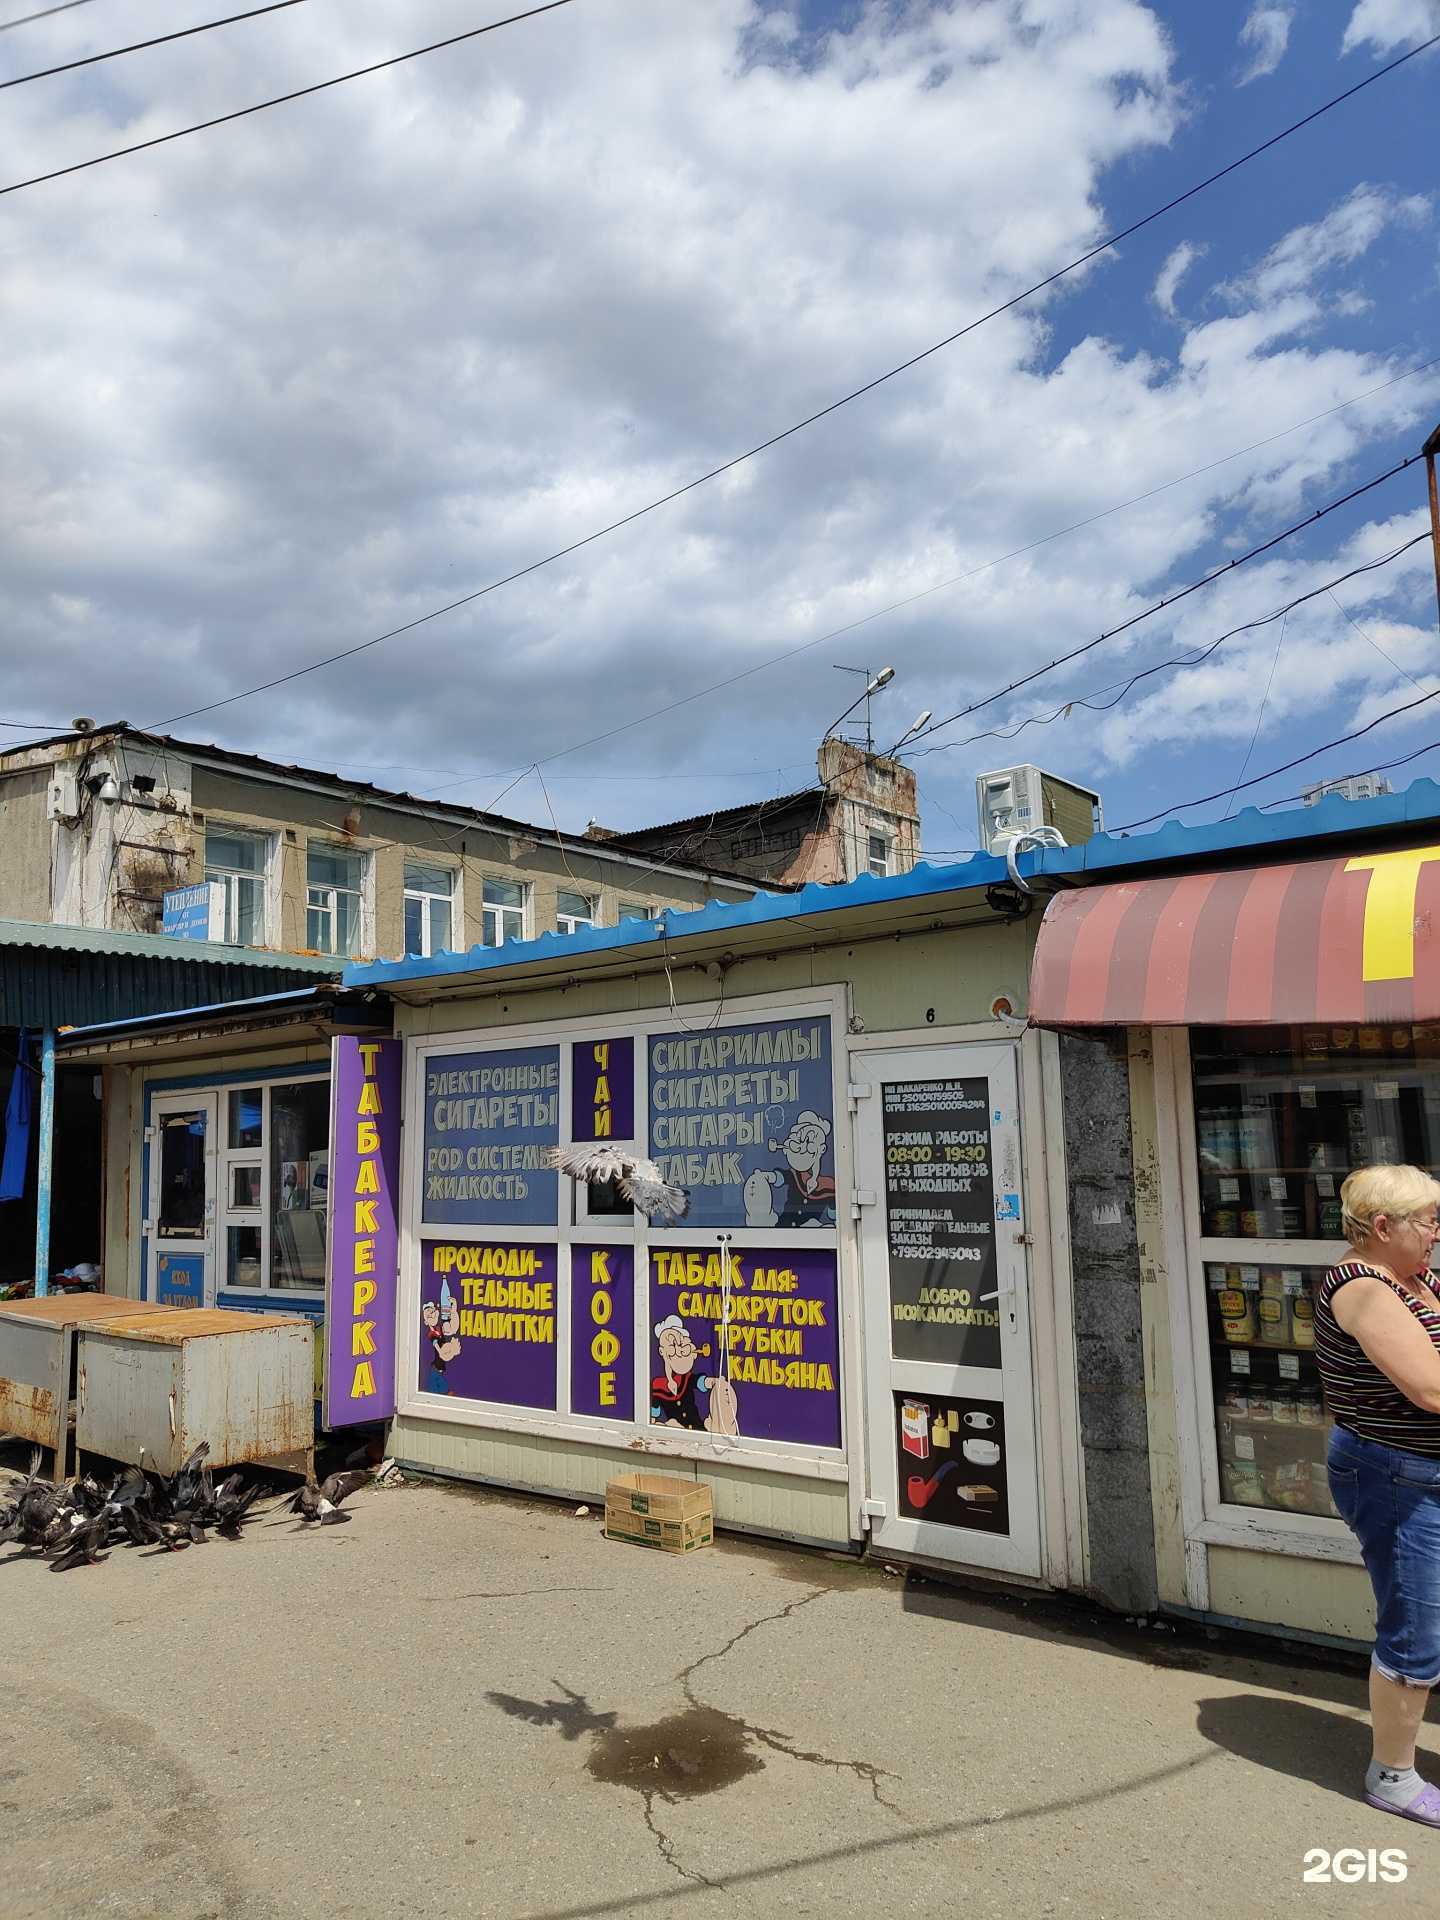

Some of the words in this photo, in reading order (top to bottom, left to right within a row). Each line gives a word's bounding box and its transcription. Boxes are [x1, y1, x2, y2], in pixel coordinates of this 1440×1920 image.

[926, 1008, 935, 1023] 6
[651, 1026, 821, 1074] СИГАРИЛЛЫ
[427, 1062, 559, 1096] ЭЛЕКТРОННЫЕ
[593, 1043, 612, 1137] ЧАЙ
[652, 1070, 800, 1111] СИГАРЕТЫ
[433, 1093, 558, 1131] СИГАРЕТЫ
[652, 1110, 765, 1149] СИГАРЫ
[887, 1131, 933, 1146] РЕЖИМ
[935, 1130, 988, 1145] РАБОТЫ
[427, 1147, 464, 1172] POD
[654, 1151, 745, 1187] ТАБАК
[887, 1147, 932, 1163] 08:00
[944, 1145, 986, 1161] 19:30
[888, 1164, 911, 1177] БЕЗ
[913, 1163, 989, 1177] ПЕРЕРЫВОВ
[426, 1174, 529, 1201] ЖИДКОСТЬ
[888, 1179, 898, 1192] И
[901, 1178, 972, 1193] ВЫХОДНЫХ
[351, 1043, 382, 1399] ТАБАКЕРКА
[890, 1209, 953, 1220] ПРИНИМАЕМ
[891, 1233, 932, 1245] ЗАКАЗЫ
[892, 1246, 981, 1260] +79502945043
[433, 1246, 543, 1277] ПРОХЛОДИ-
[652, 1251, 746, 1288] ТАБАК
[751, 1268, 799, 1293] ДЛЯ:
[460, 1278, 554, 1311] ТЕЛЬНЫЕ
[677, 1291, 826, 1326] САМОКРУТОК
[918, 1288, 970, 1306] ДОБРО
[459, 1308, 554, 1344] НАПИТКИ
[590, 1250, 620, 1406] КОФЕ
[894, 1304, 999, 1326] ПОЖАЛОВАТЬ!
[714, 1324, 803, 1355] ТРУБКИ
[728, 1355, 835, 1391] КАЛЬЯНА
